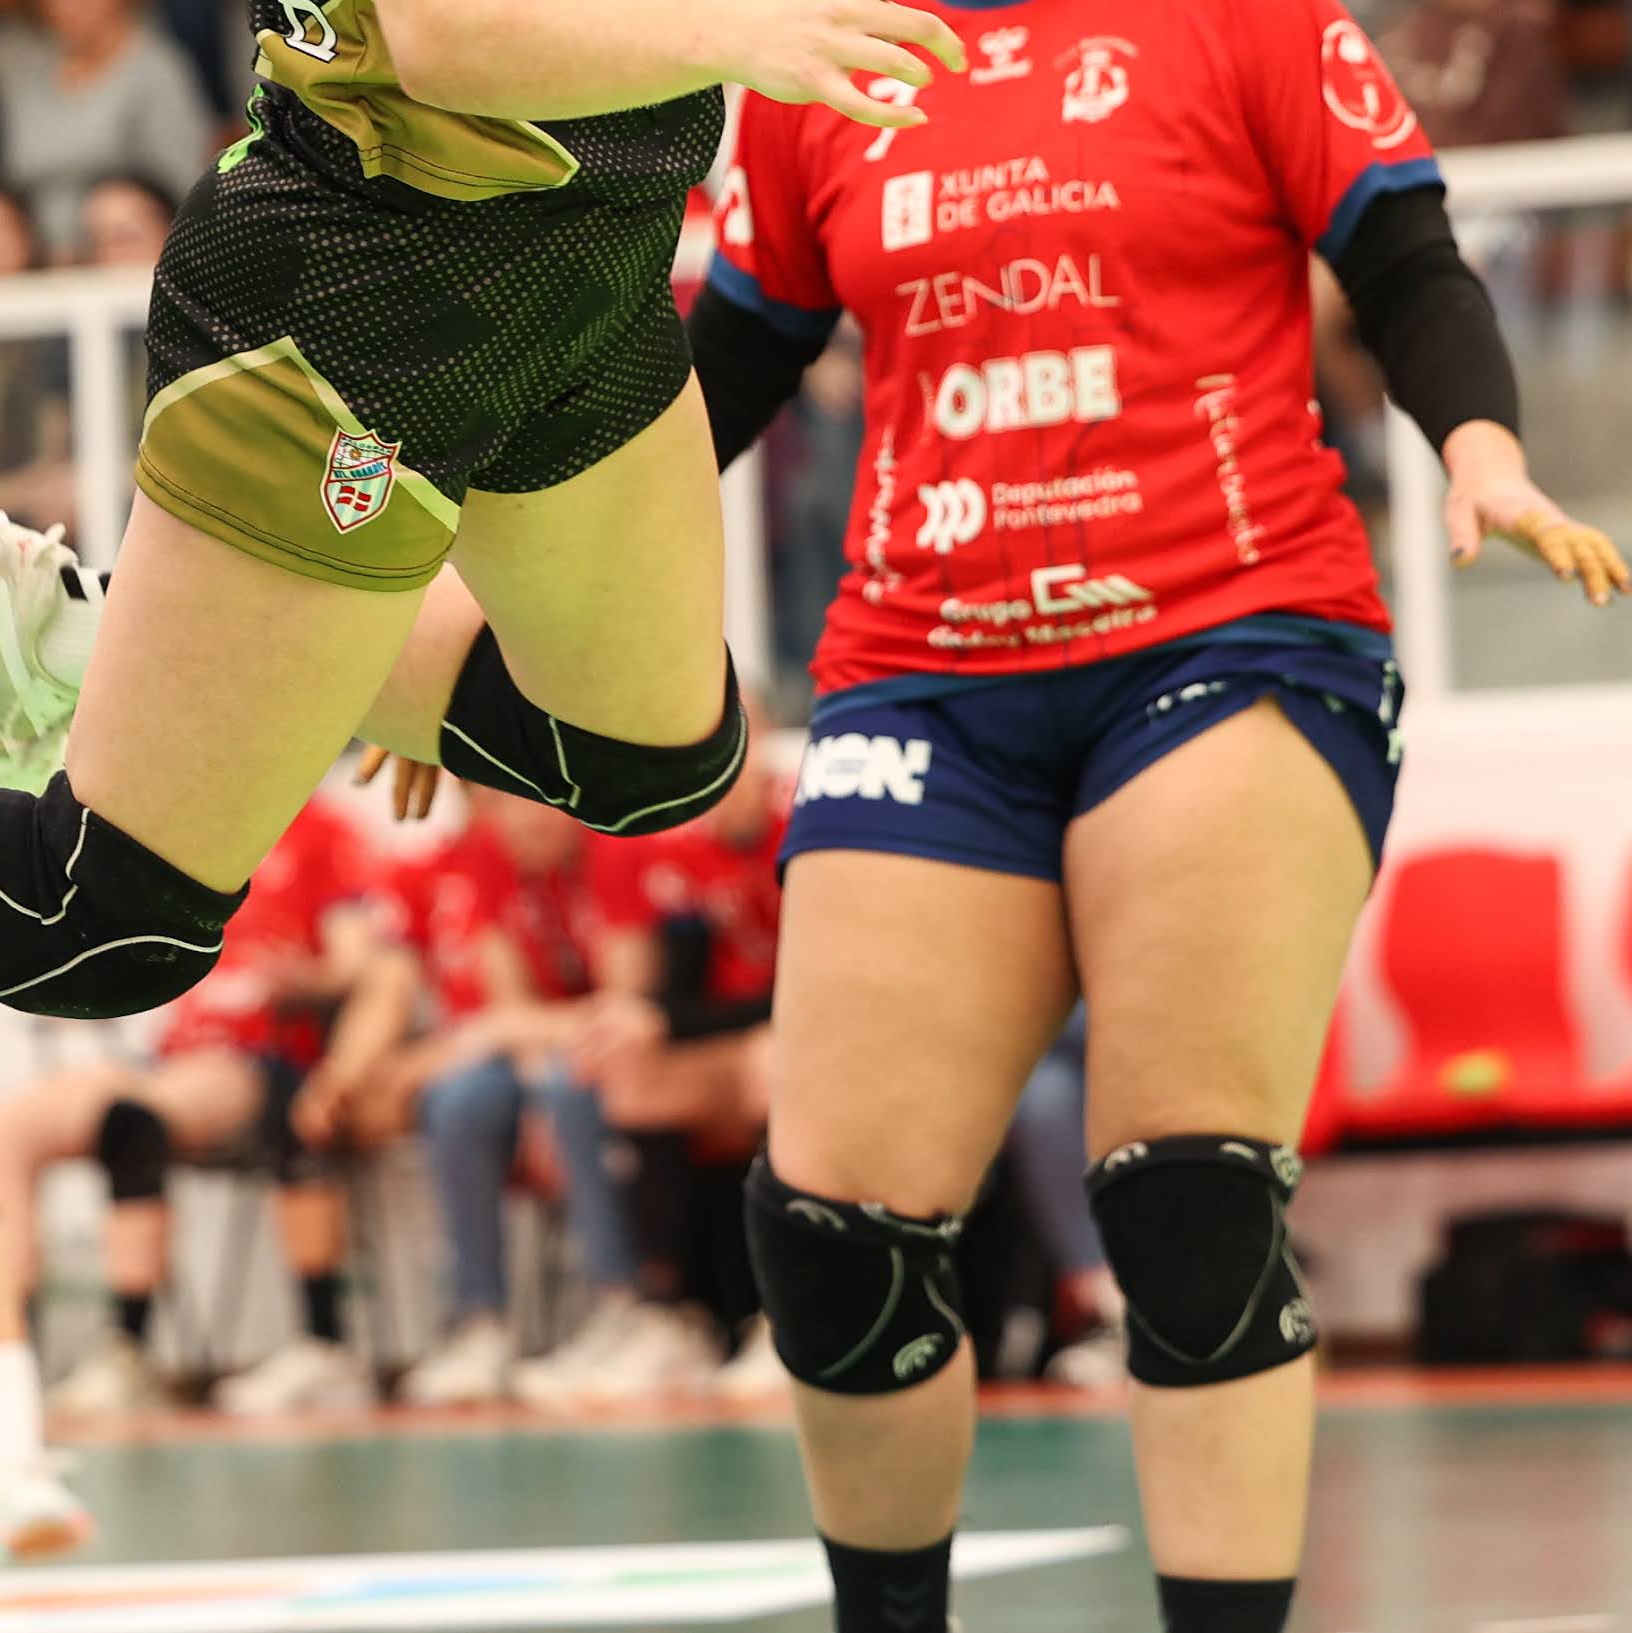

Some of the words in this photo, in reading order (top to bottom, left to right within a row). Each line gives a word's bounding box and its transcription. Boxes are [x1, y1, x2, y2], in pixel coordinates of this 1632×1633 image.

[938, 156, 1050, 200] XUNTA
[936, 199, 979, 232] DE
[985, 179, 1122, 223] GALICIA
[895, 252, 1120, 338] ZENDAL
[934, 344, 1122, 439] ORBE
[994, 491, 1142, 531] Pontevedra
